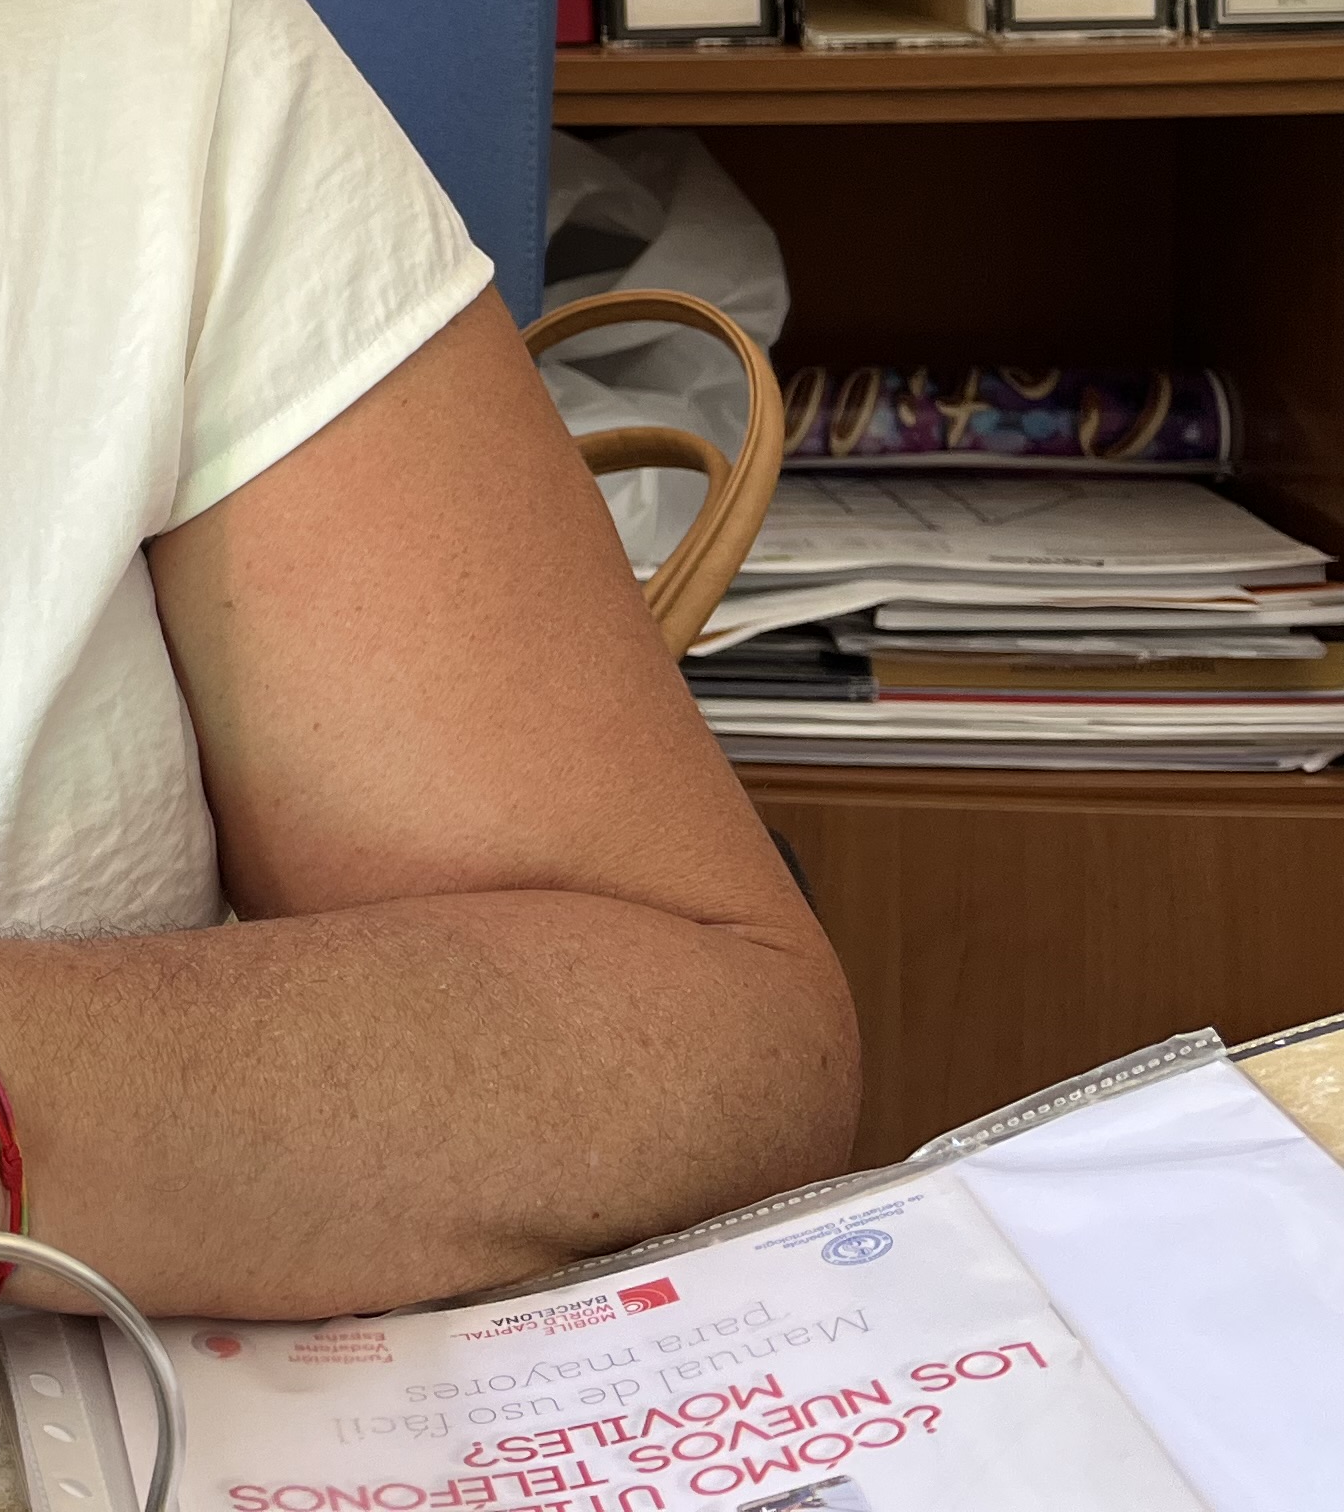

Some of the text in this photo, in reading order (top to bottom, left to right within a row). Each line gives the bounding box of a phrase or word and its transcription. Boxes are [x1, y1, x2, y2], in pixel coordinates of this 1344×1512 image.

[902, 1193, 925, 1205] de
[781, 1208, 904, 1250] Sociedad Española
[490, 1294, 609, 1326] BARCELONA
[542, 1303, 615, 1326] WORLD
[543, 1311, 617, 1336] MOBILE
[294, 1343, 389, 1354] Vodafone
[313, 1332, 385, 1342] España
[405, 1301, 777, 1403] para mayores
[330, 1308, 871, 1444] Manual de uso fácil
[228, 1341, 1049, 1512] LOS NUEVOS TELÉFONOS
[463, 1374, 784, 1468] MÓVILES?
[690, 1405, 943, 1497] ¿CÓMO
